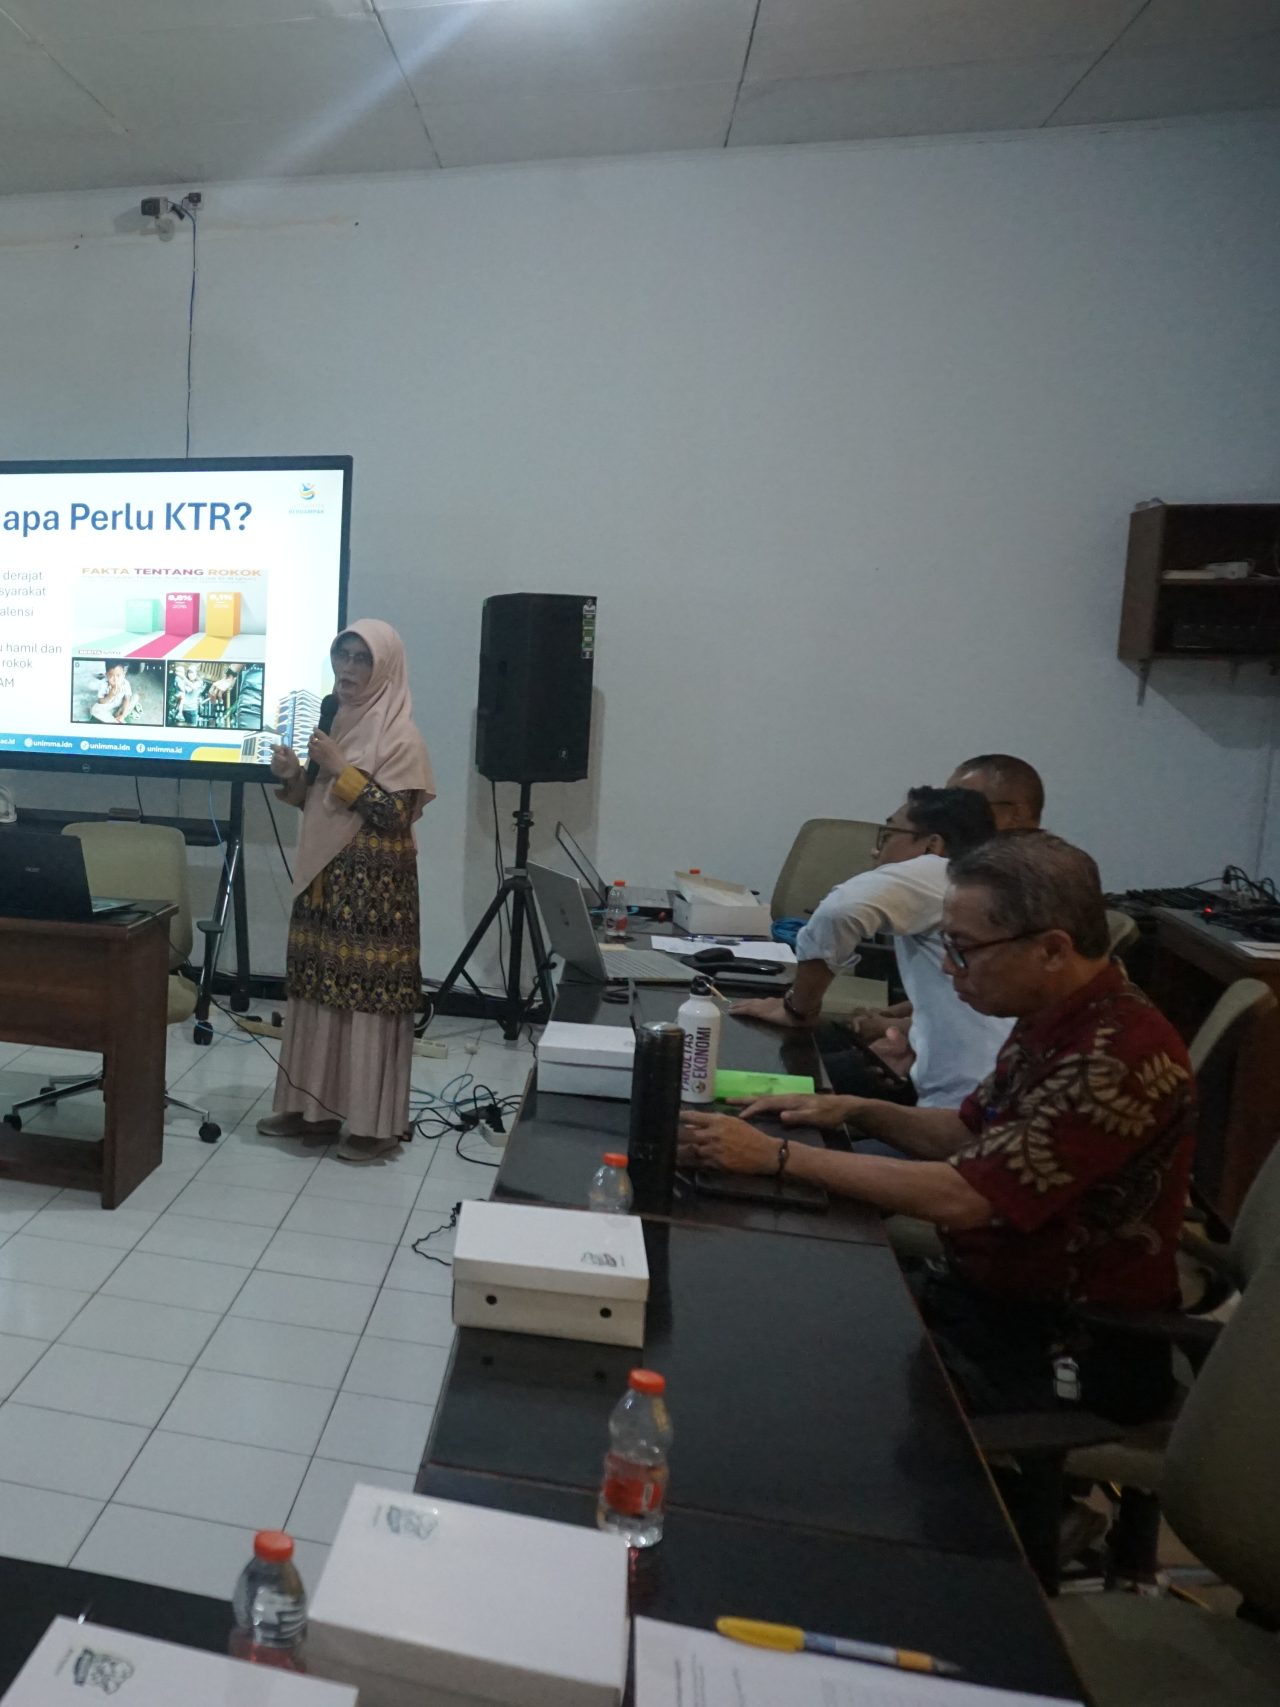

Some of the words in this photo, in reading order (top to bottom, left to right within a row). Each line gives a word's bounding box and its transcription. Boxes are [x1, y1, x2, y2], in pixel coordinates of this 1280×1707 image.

[70, 502, 154, 531] Perlu
[165, 501, 253, 531] KTR?
[3, 570, 43, 582] derajat
[81, 567, 130, 575] FAKTA
[134, 568, 204, 576] TENTANG
[208, 568, 262, 577] ROKOK
[6, 642, 37, 653] hamil
[40, 643, 63, 654] dan
[2, 657, 33, 668] rokok
[33, 739, 73, 748] unimma.idn
[89, 743, 131, 751] unimma.idn
[147, 746, 183, 754] unimma.id
[692, 1026, 712, 1079] EKONOMI
